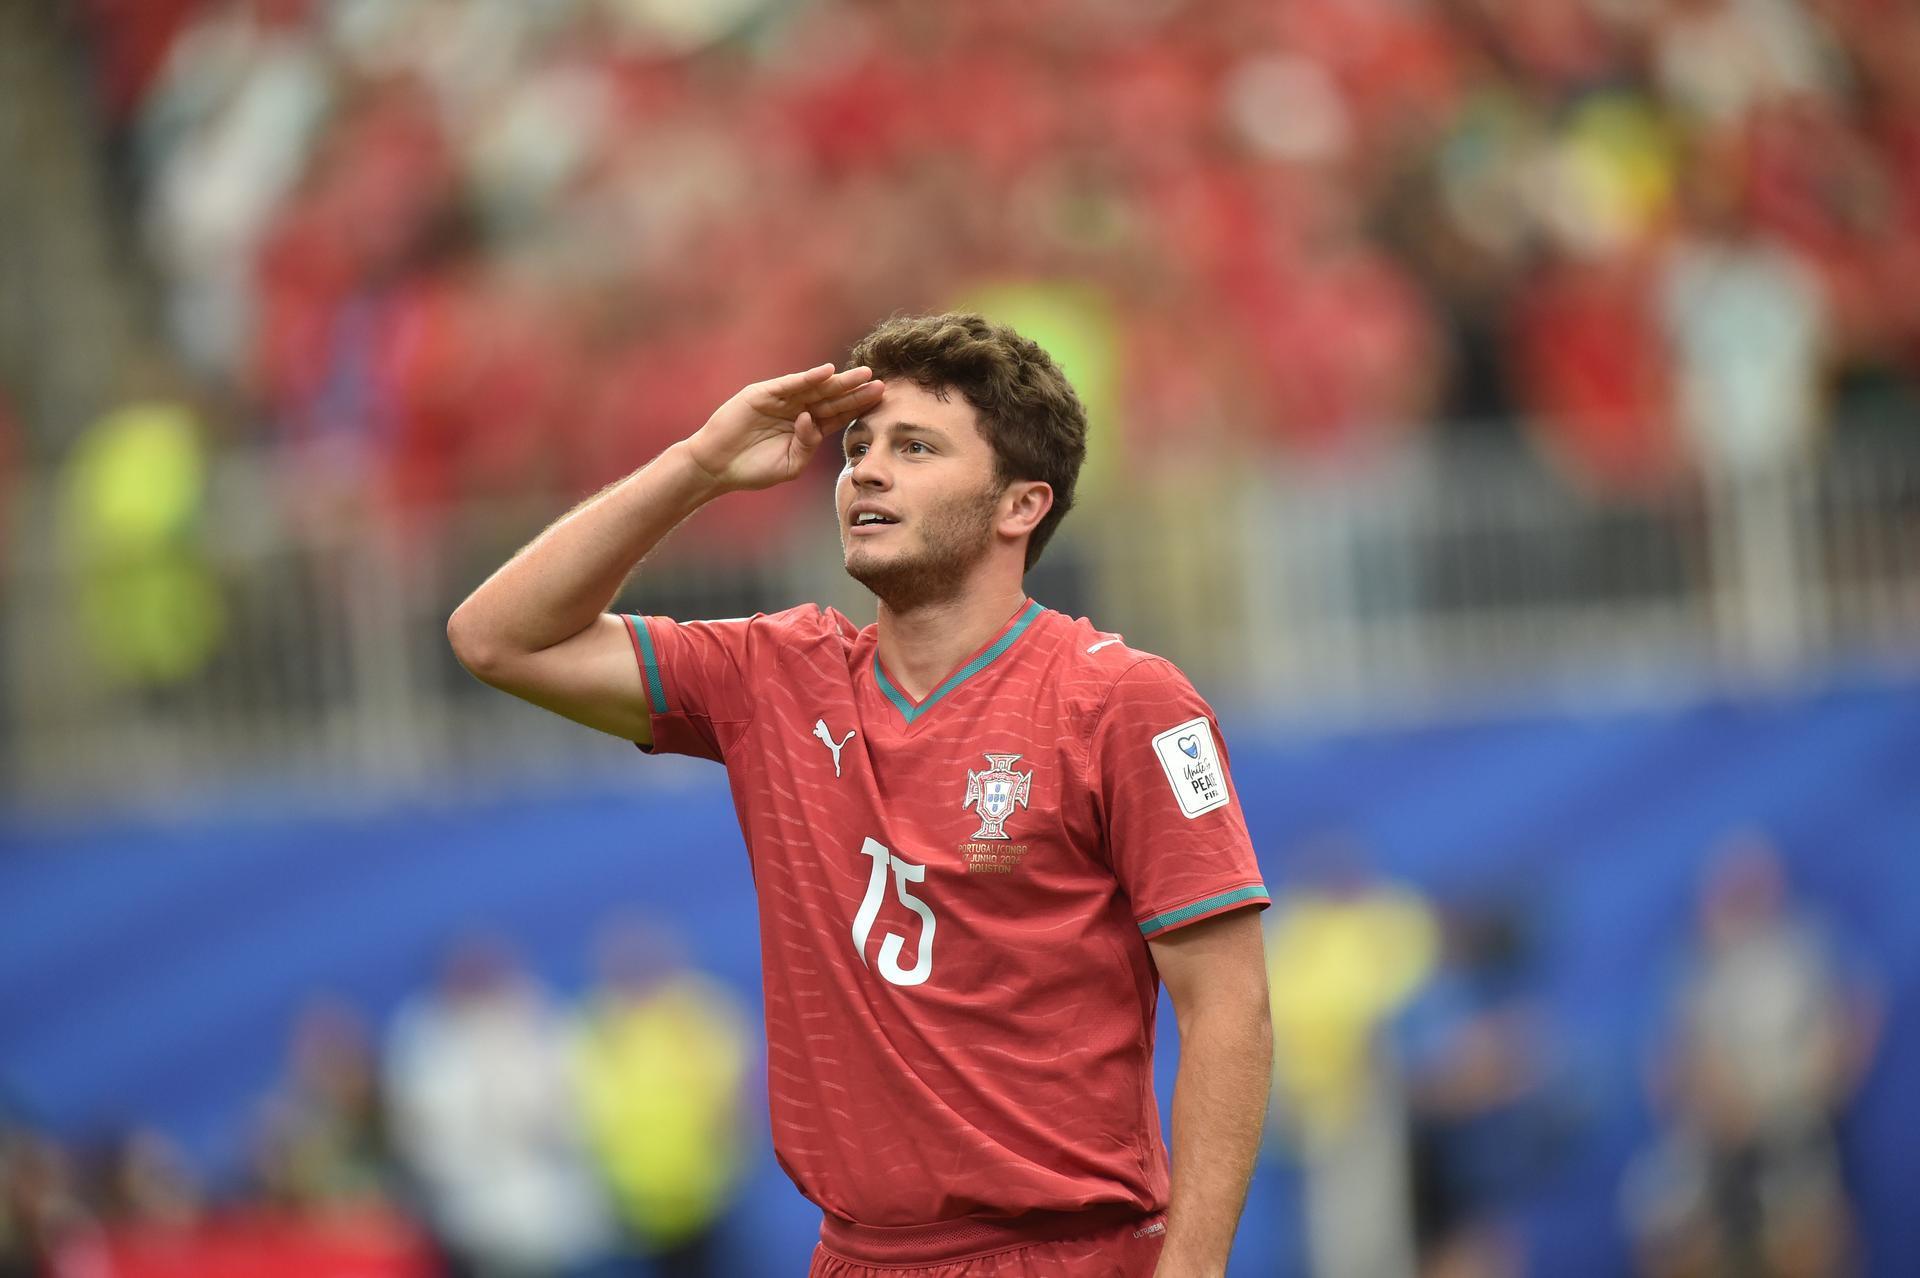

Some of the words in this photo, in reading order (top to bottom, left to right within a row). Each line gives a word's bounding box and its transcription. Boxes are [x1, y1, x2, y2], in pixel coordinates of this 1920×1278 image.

[970, 854, 997, 863] JUNHO
[969, 863, 1011, 873] HOUSTON
[852, 836, 937, 986] 15
